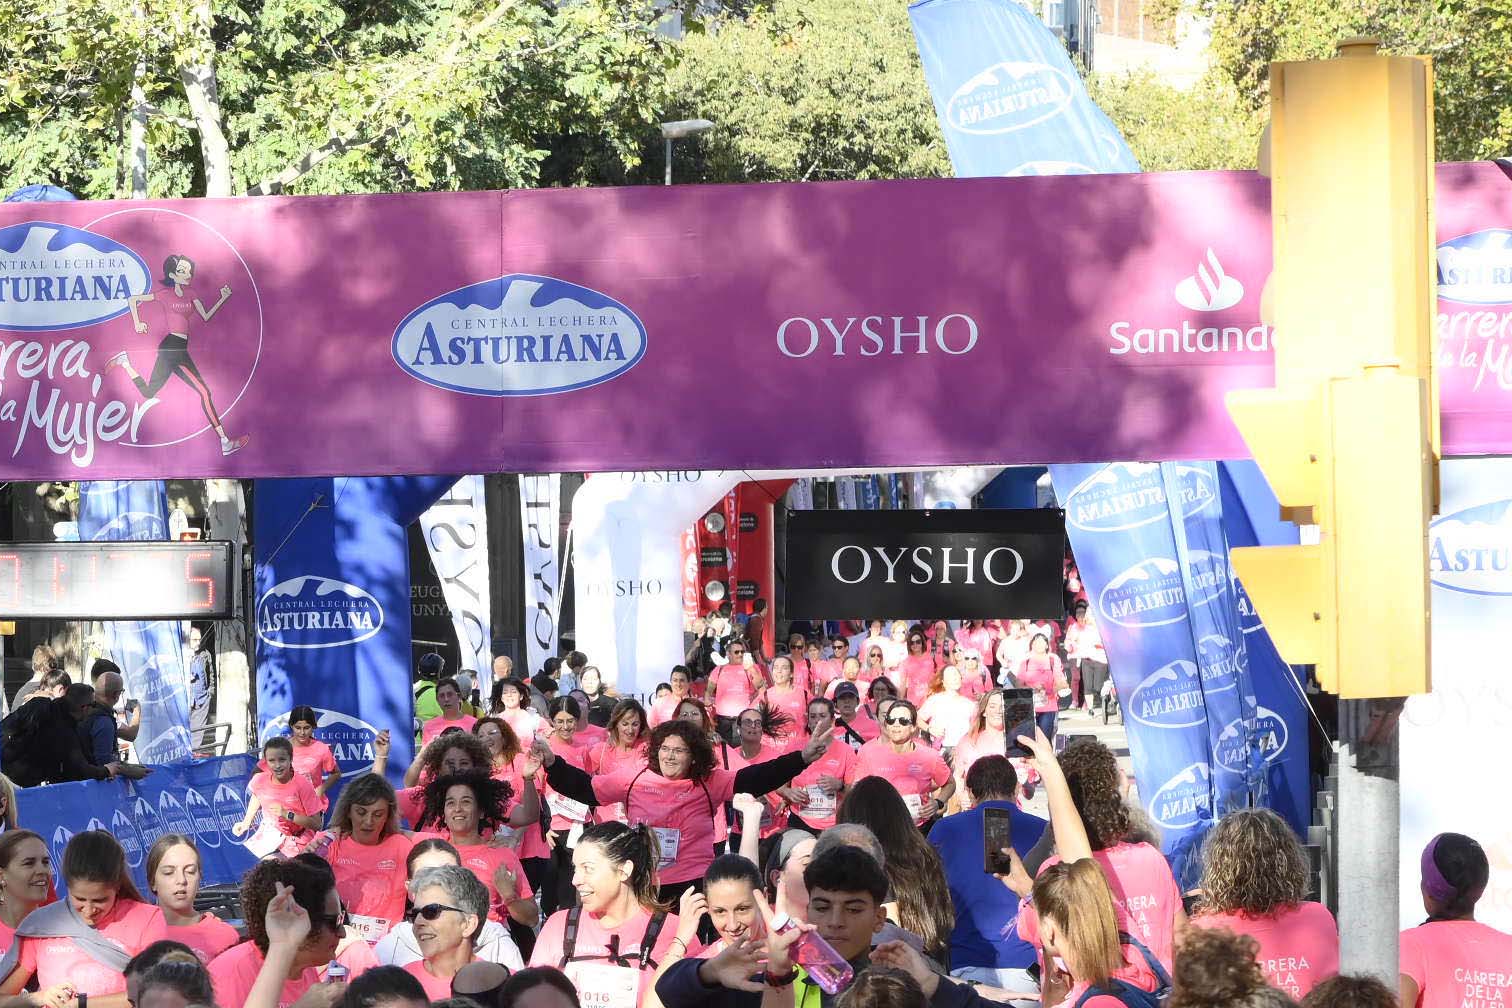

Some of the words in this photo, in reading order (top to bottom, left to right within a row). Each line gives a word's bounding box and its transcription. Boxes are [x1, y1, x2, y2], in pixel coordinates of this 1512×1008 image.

[54, 257, 127, 270] LECHERA
[451, 315, 529, 330] CENTRAL
[538, 314, 619, 328] LECHERA
[411, 321, 627, 367] ASTURIANA
[776, 313, 980, 358] OYSHO
[12, 374, 161, 468] Mujer
[831, 545, 1025, 587] OYSHO
[273, 601, 316, 609] CENTRAL
[320, 600, 370, 608] LECHERA
[261, 605, 375, 633] ASTURIANA
[321, 731, 370, 740] LECHERA
[1276, 972, 1296, 985] LA
[584, 991, 610, 1003] 016
[1465, 983, 1484, 999] DE
[1485, 986, 1504, 1001] LA
